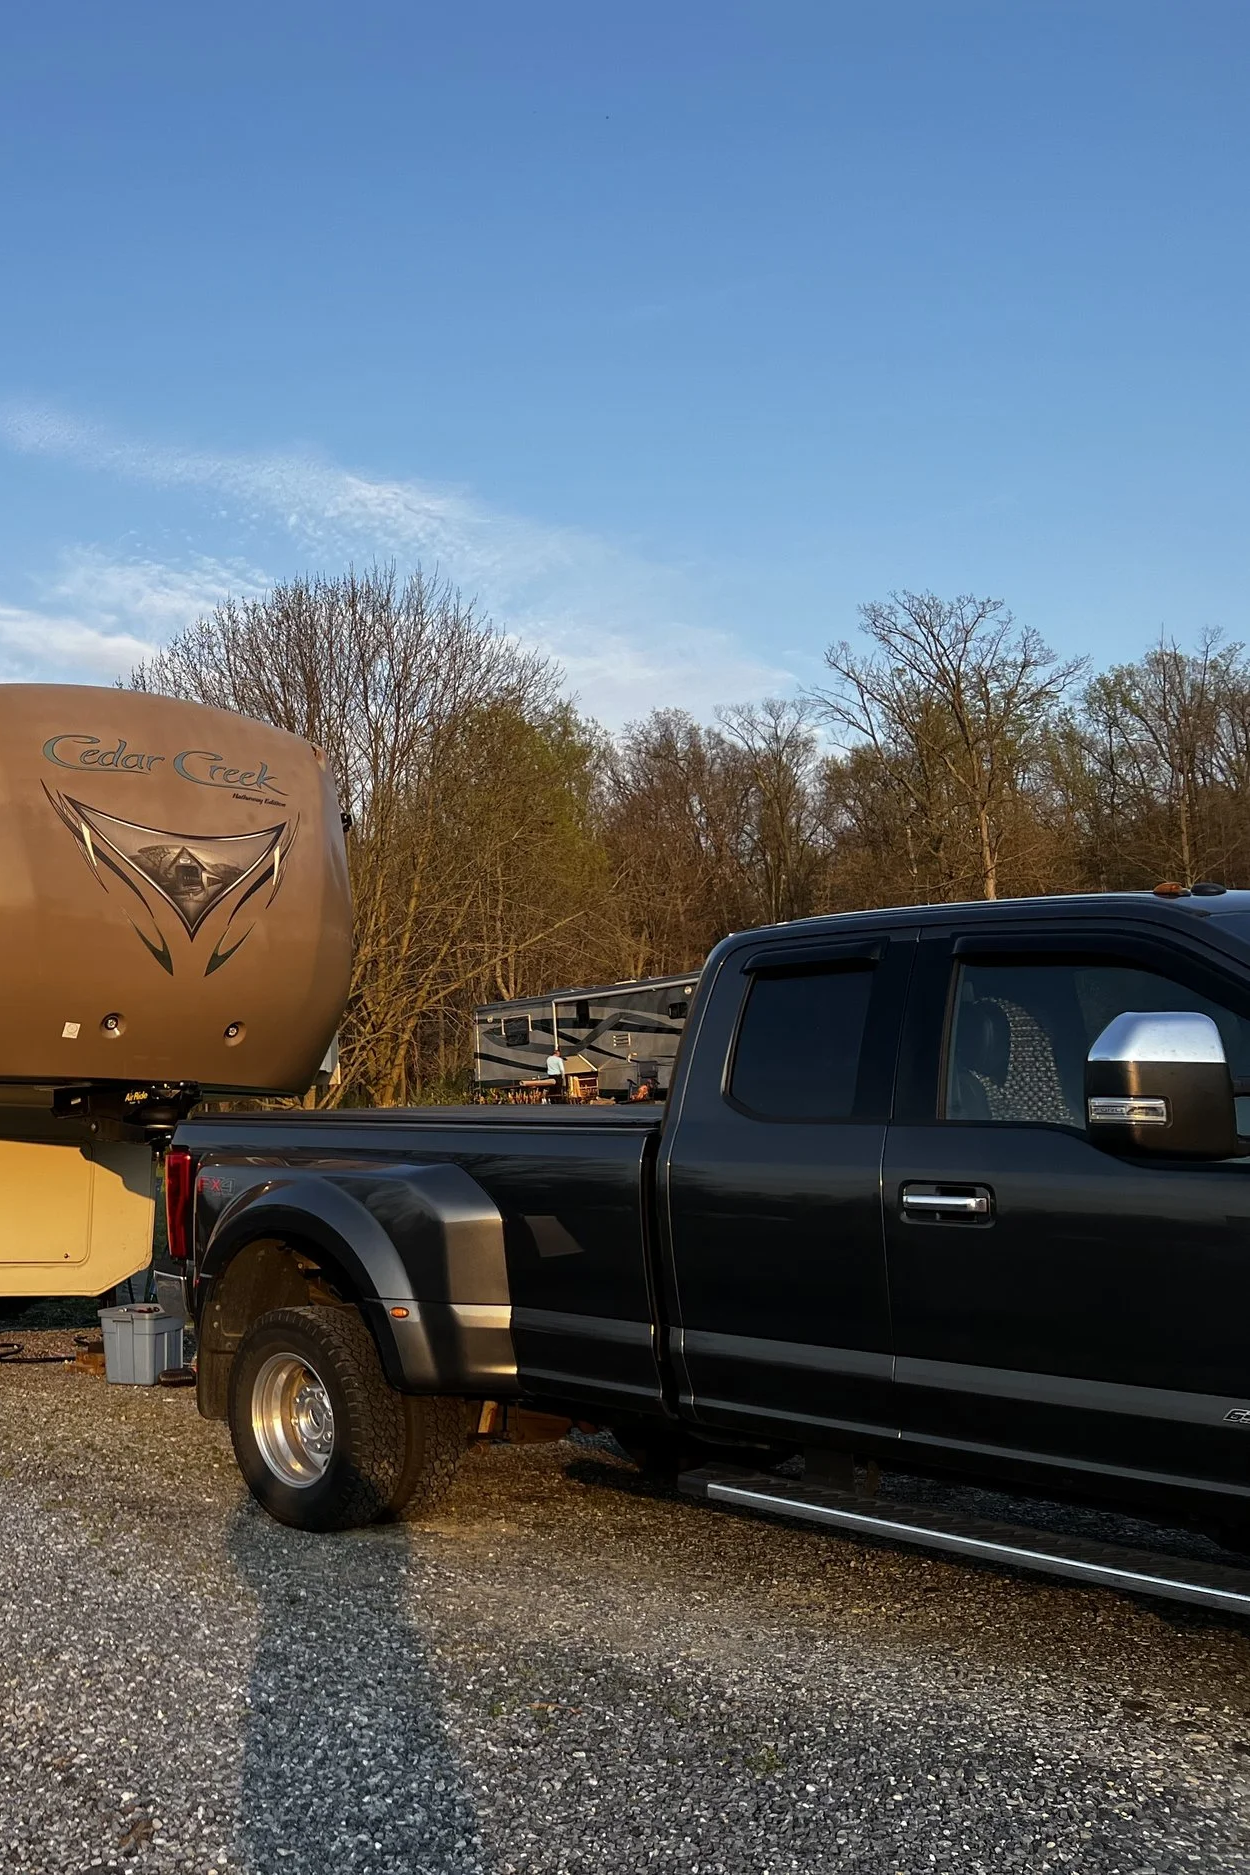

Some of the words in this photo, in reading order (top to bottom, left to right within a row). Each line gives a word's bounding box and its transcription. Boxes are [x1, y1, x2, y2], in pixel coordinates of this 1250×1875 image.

[42, 734, 166, 775] Cedar
[173, 750, 289, 796] Creek
[197, 1175, 235, 1195] FX4
